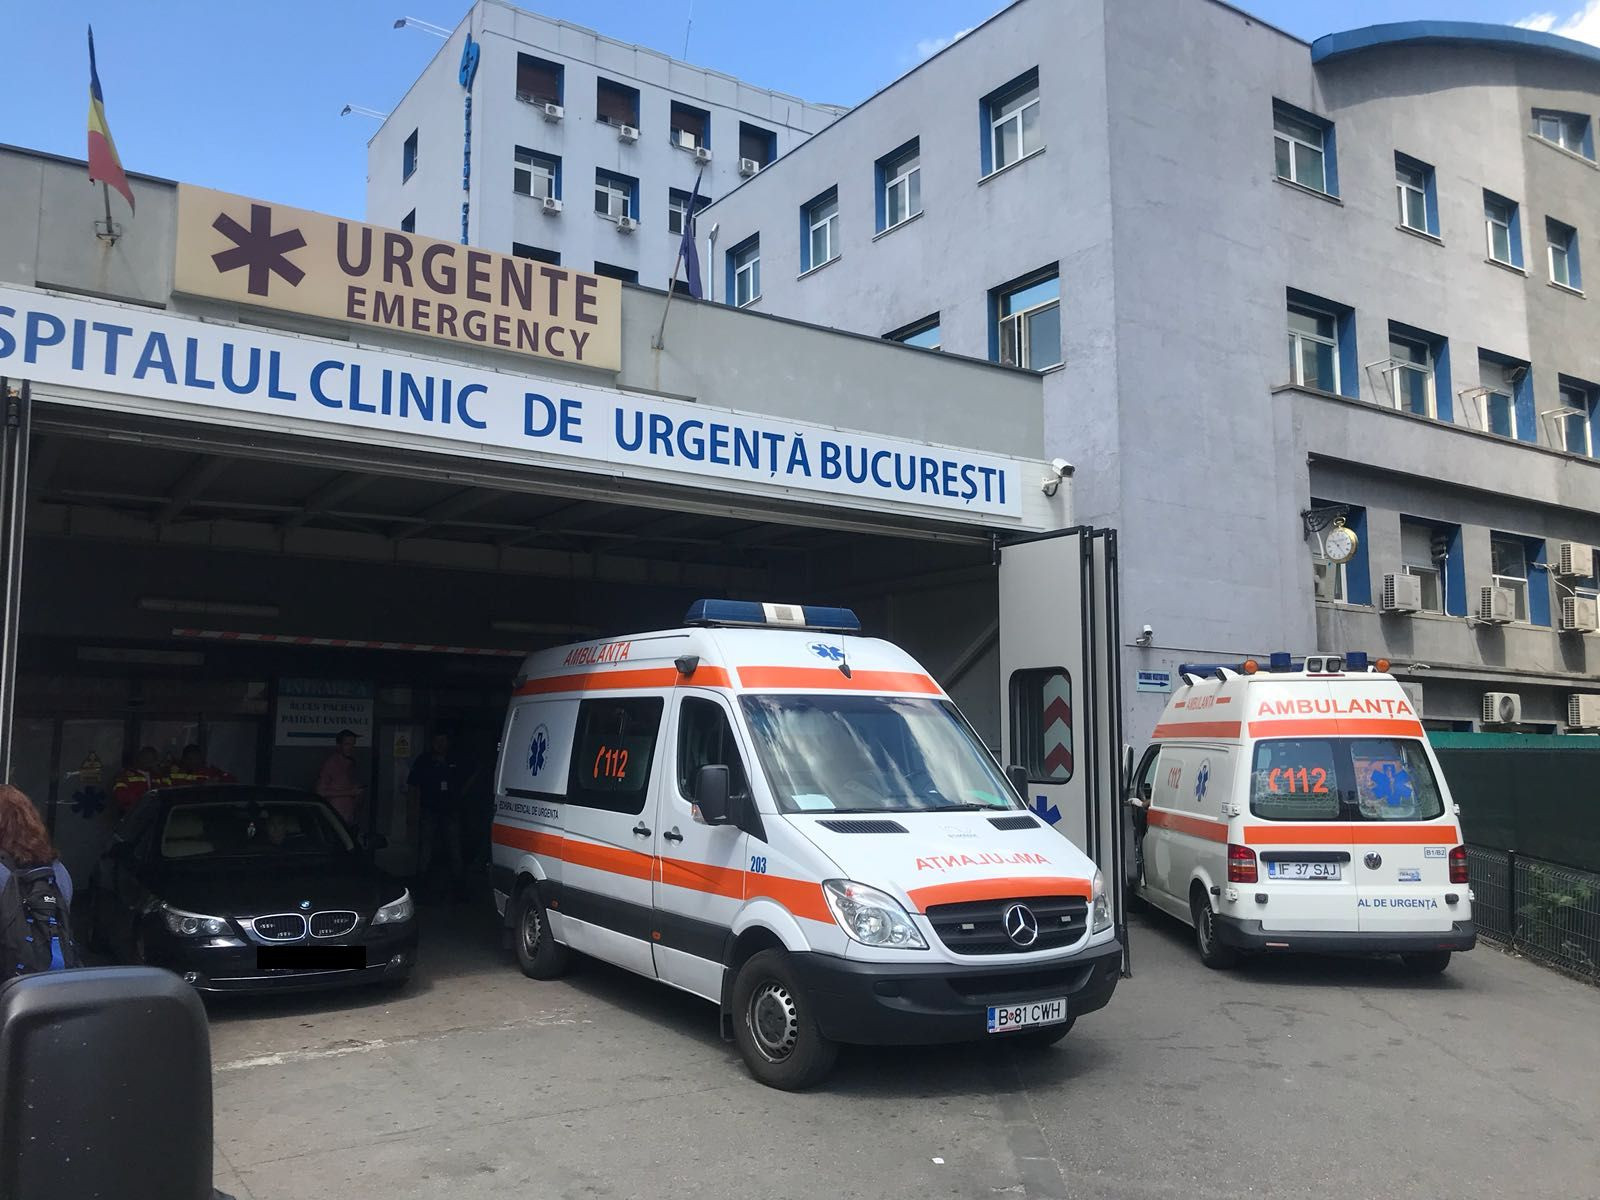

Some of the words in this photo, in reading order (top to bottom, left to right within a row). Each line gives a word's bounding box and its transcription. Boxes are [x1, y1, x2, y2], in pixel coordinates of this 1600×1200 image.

[337, 222, 598, 325] URGENTE
[346, 285, 590, 361] EMERGENCY
[309, 359, 489, 430] CLINIC
[523, 391, 583, 444] DE
[614, 405, 812, 478] URGENȚĂ
[820, 441, 1006, 505] BUCUREȘTI
[1257, 699, 1413, 718] AMBULANȚA
[605, 749, 628, 777] 112
[1283, 767, 1329, 793] 112
[750, 855, 767, 873] 203
[1279, 863, 1290, 875] IF
[1295, 863, 1309, 875] 37
[1313, 863, 1336, 876] SAJ
[1358, 899, 1371, 907] AL
[1373, 899, 1387, 907] DE
[998, 1009, 1008, 1026] B
[1014, 1006, 1027, 1024] 81
[1031, 1002, 1061, 1021] CWH
